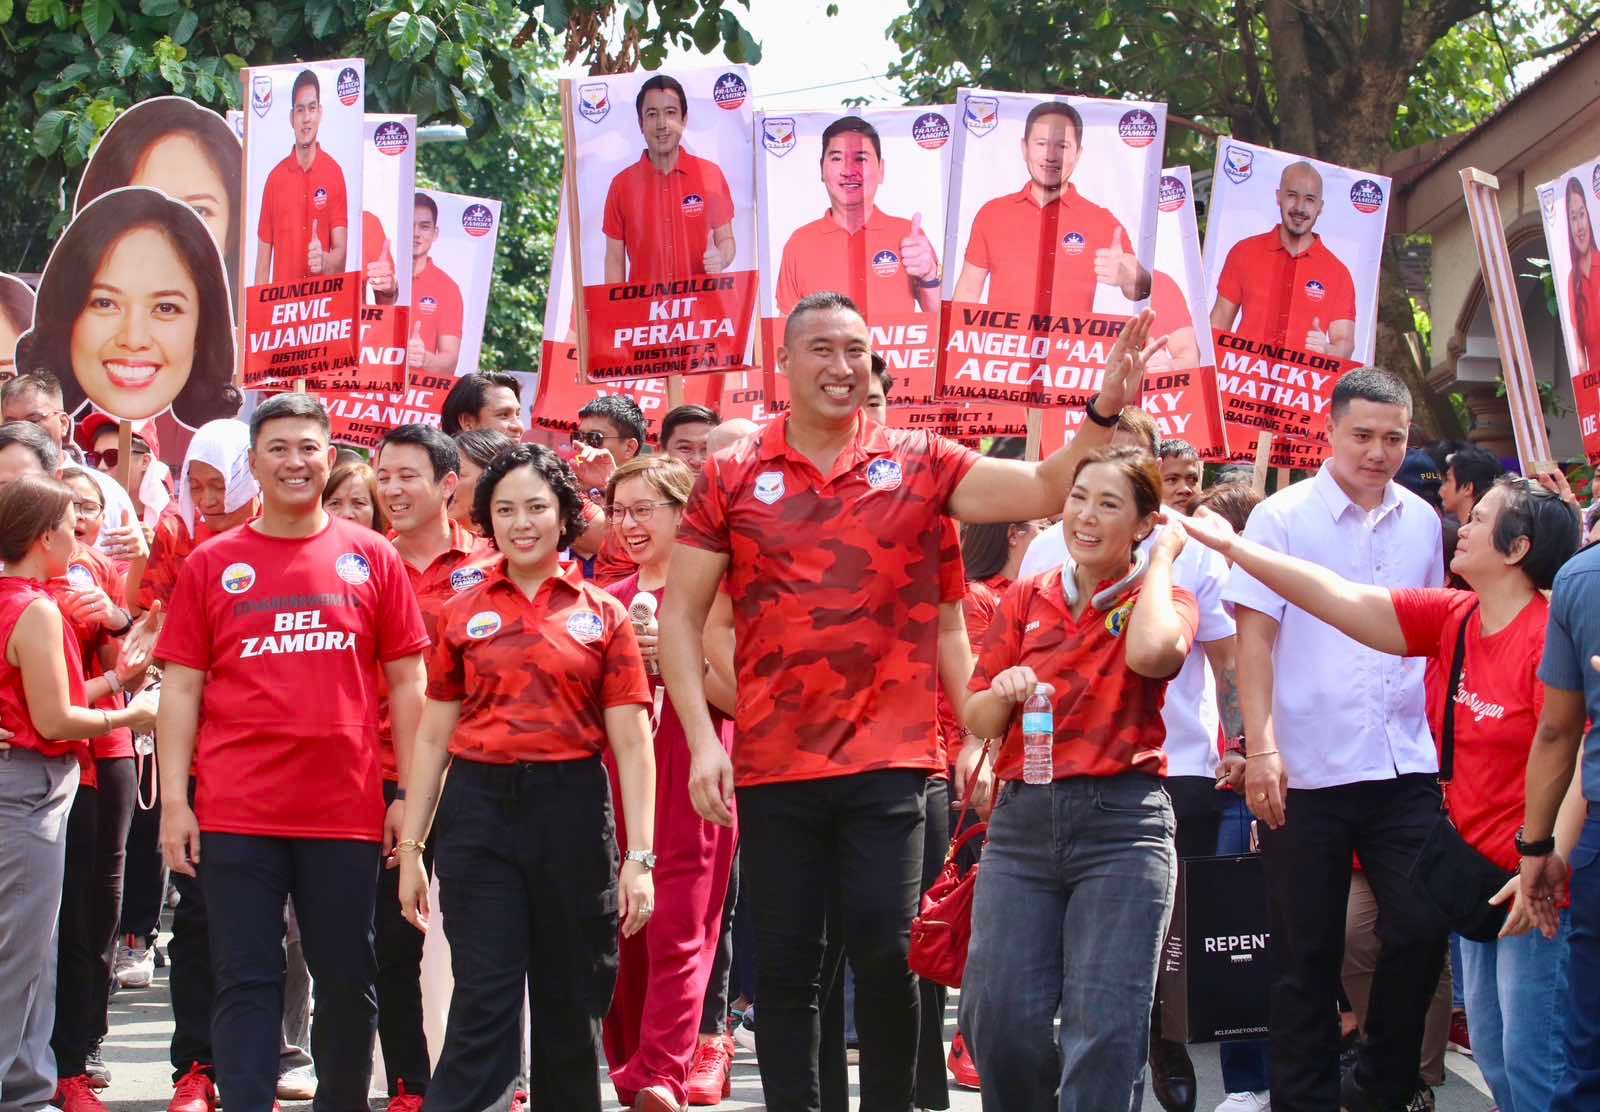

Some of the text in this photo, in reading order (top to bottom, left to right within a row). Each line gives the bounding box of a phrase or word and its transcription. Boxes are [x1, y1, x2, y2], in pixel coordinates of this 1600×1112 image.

[375, 133, 408, 141] FRANCIS
[915, 125, 949, 135] FRANCIS
[915, 130, 950, 140] ZAMORA
[375, 139, 409, 147] ZAMORA
[259, 277, 344, 302] COUNCILOR
[609, 276, 736, 301] COUNCILOR
[271, 297, 332, 325] ERVIC
[648, 296, 699, 321] KIT
[613, 317, 736, 349] PERALTA
[962, 308, 1126, 338] VICE MAYOR
[250, 318, 353, 353] VIJANDRE
[945, 329, 1051, 359] ANGELO
[272, 347, 320, 364] DISTRICT
[633, 342, 716, 361] DISTRICT 2
[1217, 333, 1341, 373] COUNCILOR
[310, 361, 329, 373] SAN
[331, 356, 357, 370] JUAN
[592, 361, 687, 379] MAKABAGONG
[689, 355, 719, 370] SAN
[1220, 351, 1332, 391] MACKY
[331, 379, 360, 391] SAN
[364, 380, 405, 393] JUAN
[940, 384, 1052, 404] MAKABAGONG
[1217, 373, 1330, 415] MATHAY
[319, 397, 441, 429] VIJANDR
[909, 412, 993, 423] DISTRICT 1
[1228, 398, 1311, 425] DISTRICT 2
[968, 425, 997, 434] SAN
[999, 424, 1028, 434] JUA
[1283, 423, 1310, 437] SAN
[1582, 414, 1598, 437] DE
[1316, 446, 1323, 455] 1
[273, 609, 328, 633] BEL
[239, 631, 357, 659] ZAMORA
